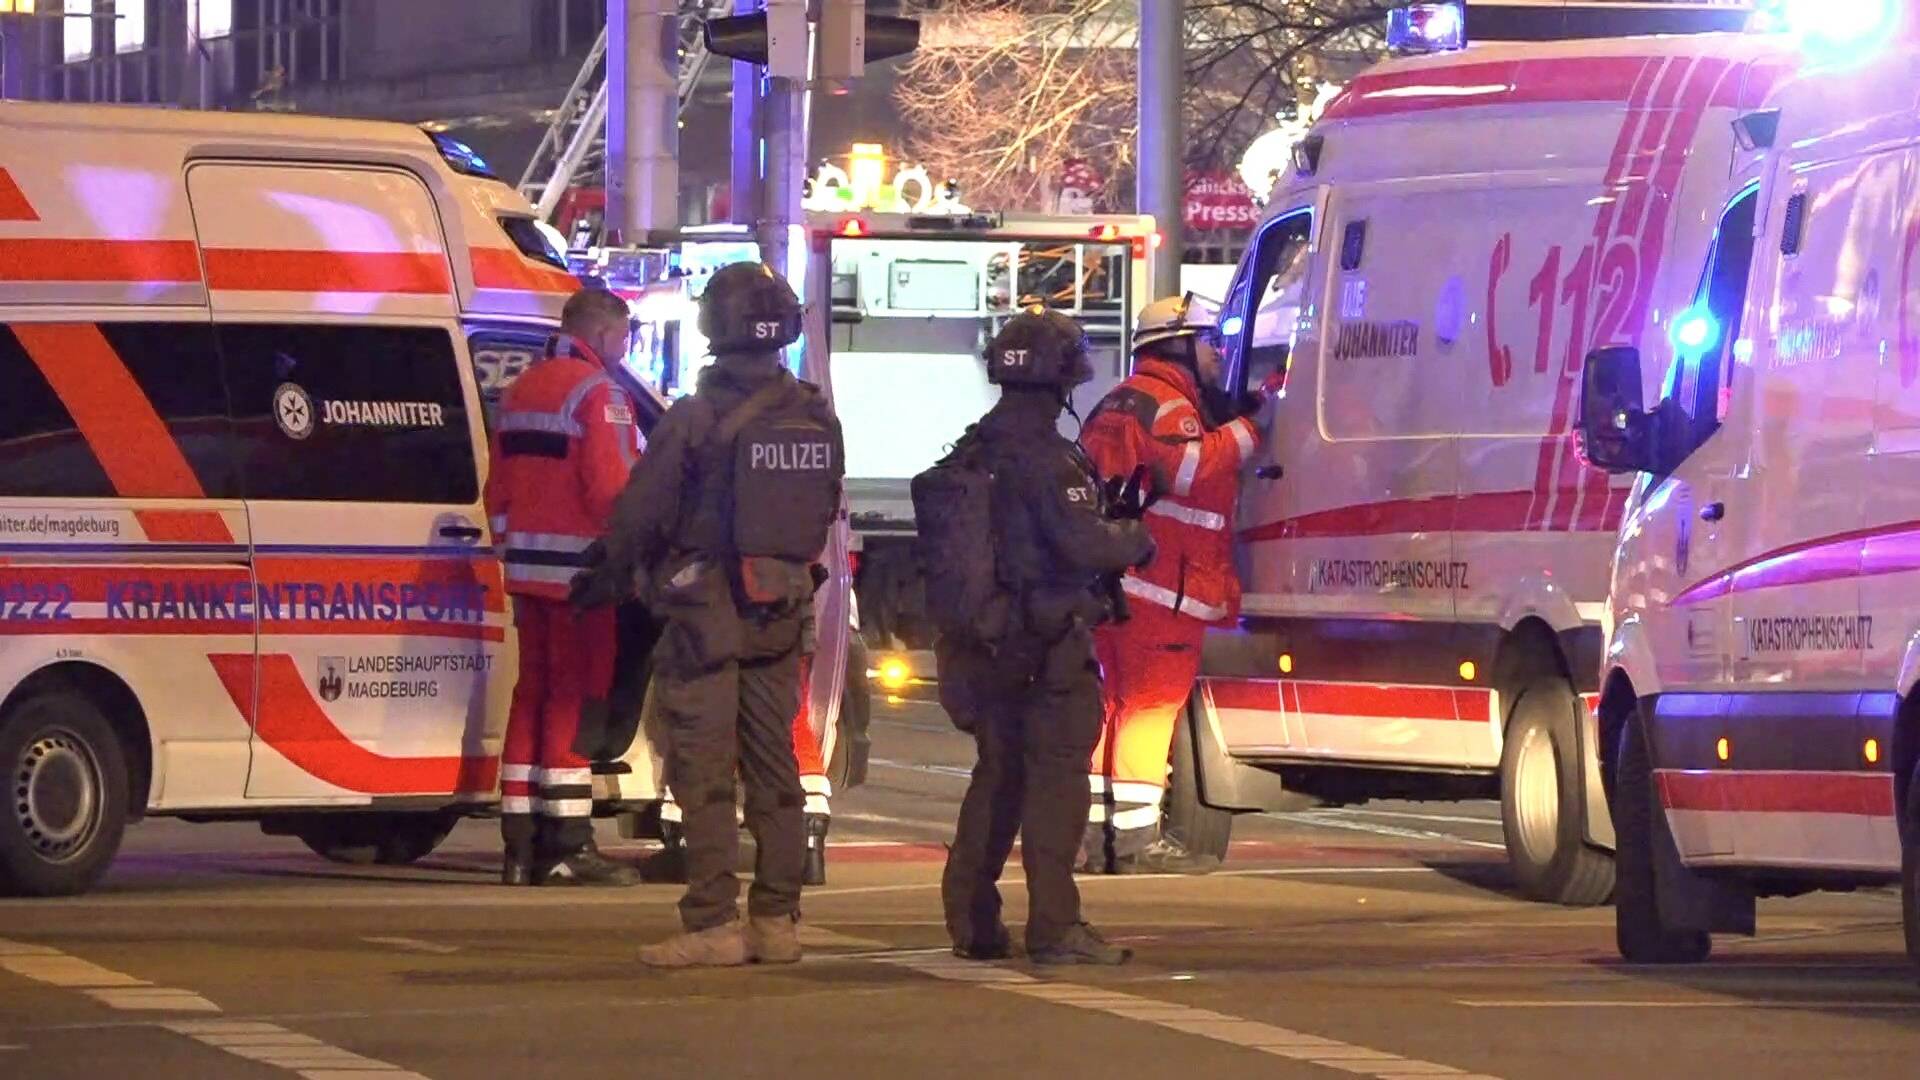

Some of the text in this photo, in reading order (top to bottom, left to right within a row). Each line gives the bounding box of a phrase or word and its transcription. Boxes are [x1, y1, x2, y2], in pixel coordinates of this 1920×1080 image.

[1187, 200, 1264, 222] Presse
[1529, 238, 1641, 373] 112
[755, 322, 780, 339] ST
[1334, 322, 1419, 361] JOHANNITER
[1003, 350, 1028, 367] ST
[323, 400, 444, 427] JOHANNITER
[751, 443, 832, 471] POLIZEI
[1066, 487, 1088, 502] ST
[1319, 559, 1469, 589] KATASTROPHENSCHUTZ
[105, 580, 489, 622] KRANKENTRANSPORT
[1751, 615, 1874, 651] KATASTROPHENSCHUTZ
[348, 654, 493, 673] LANDESHAUPTSTADT
[347, 680, 438, 698] MAGDEBURG
